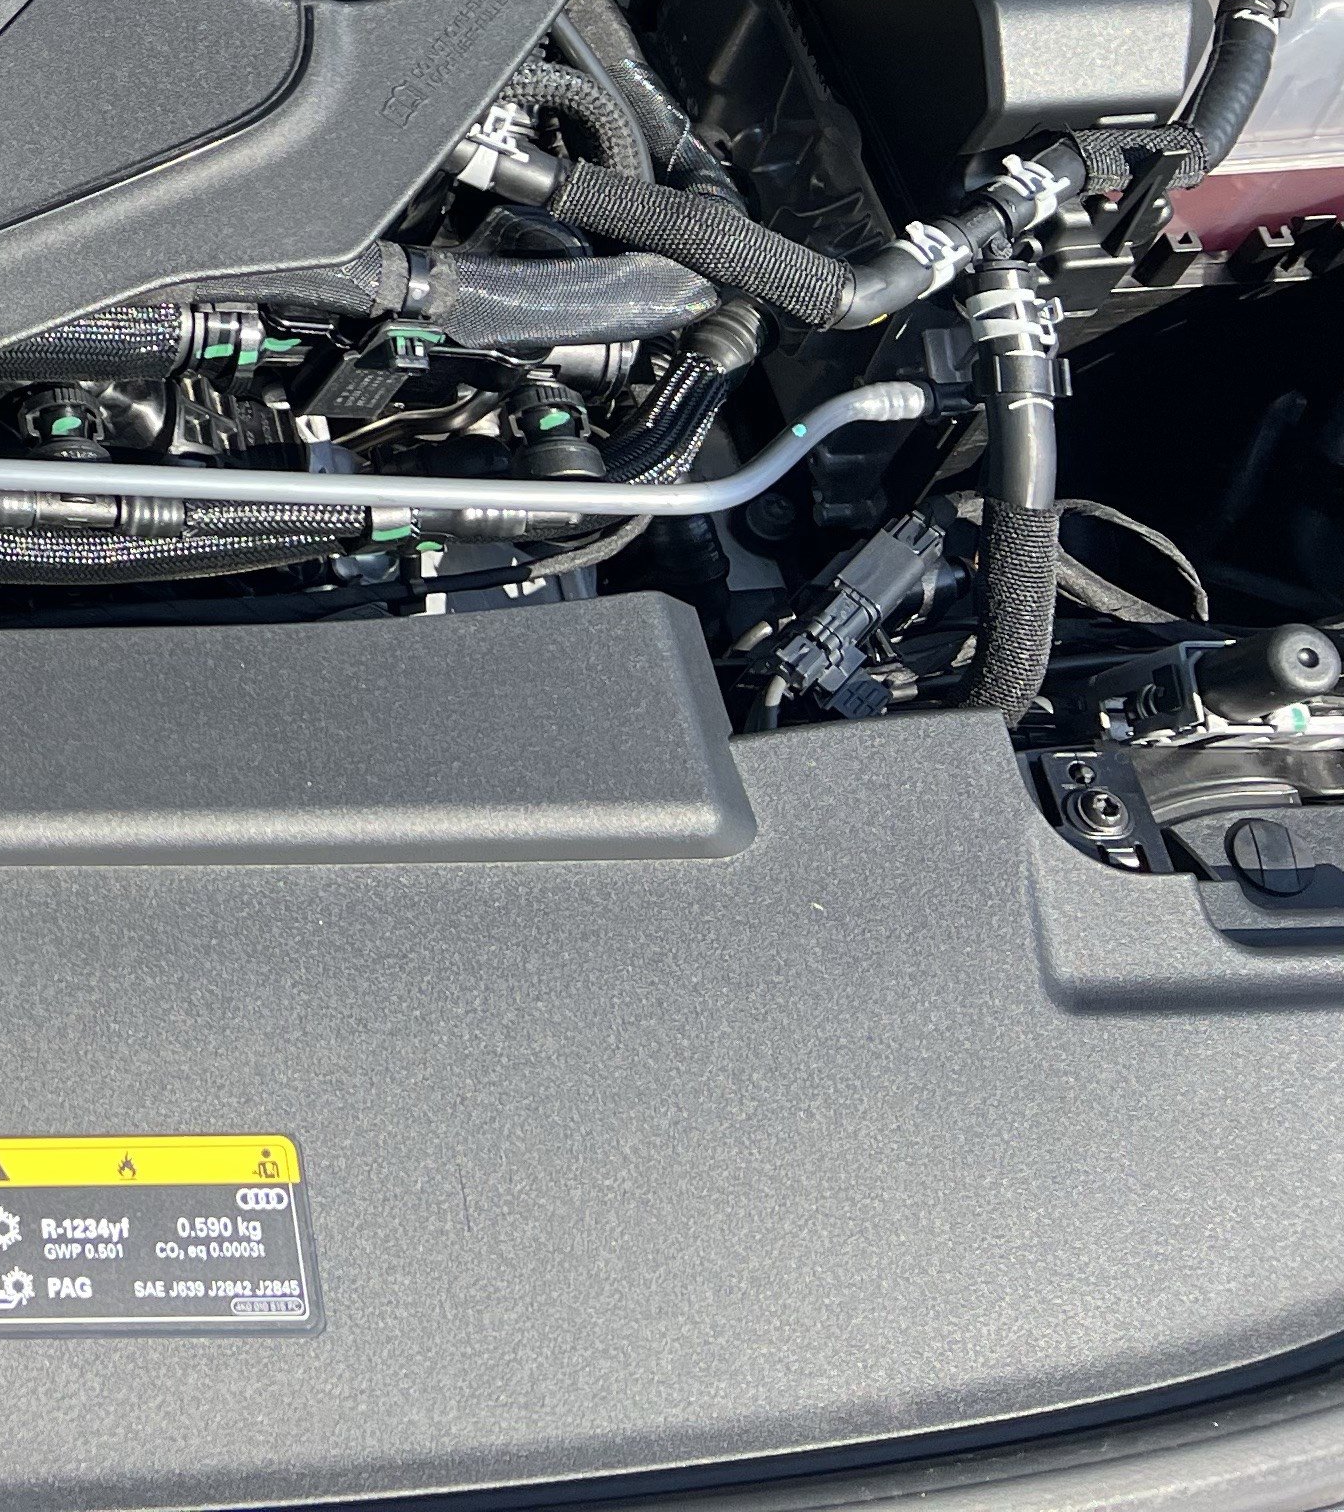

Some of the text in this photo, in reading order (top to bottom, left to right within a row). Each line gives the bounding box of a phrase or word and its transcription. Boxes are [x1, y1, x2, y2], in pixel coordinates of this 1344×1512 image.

[41, 1217, 262, 1241] R-1234yf 0.590 kg
[44, 1243, 124, 1259] GWP 0.501
[188, 1245, 207, 1260] eq
[47, 1277, 93, 1299] PAG
[134, 1280, 165, 1297] SAE
